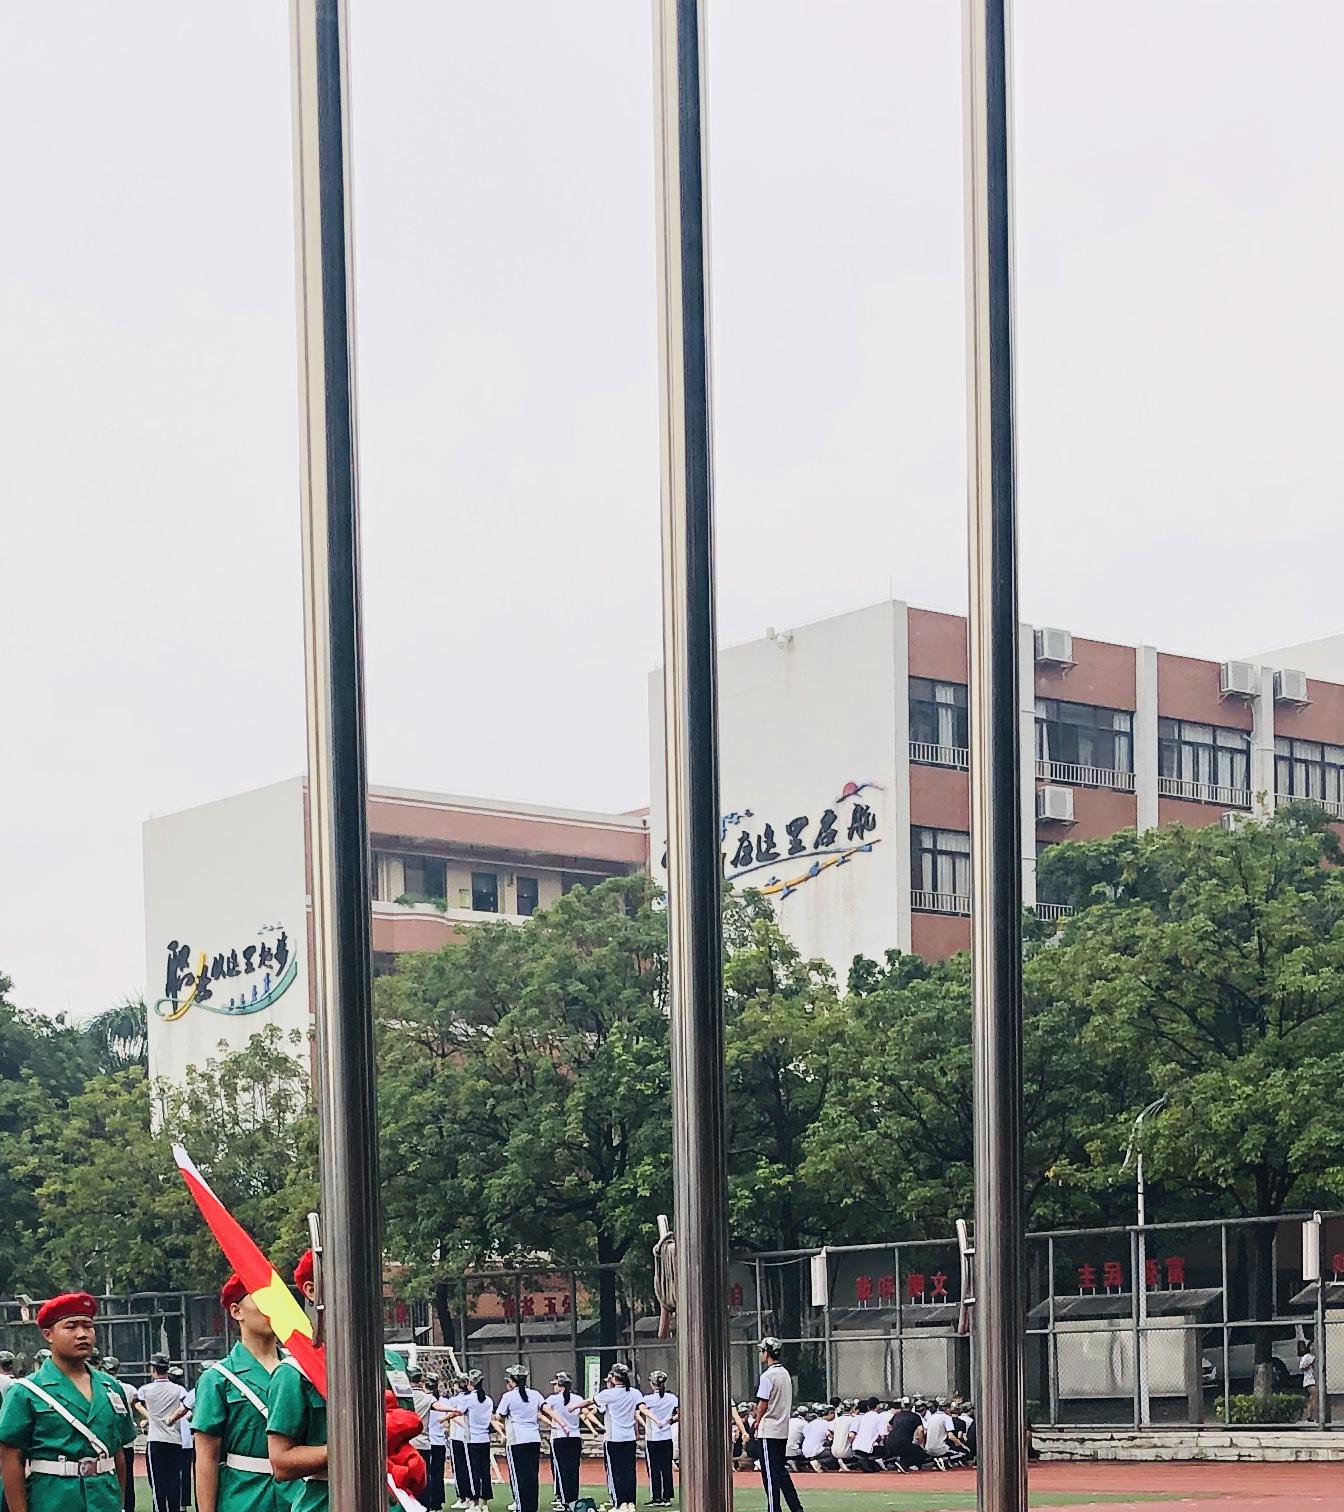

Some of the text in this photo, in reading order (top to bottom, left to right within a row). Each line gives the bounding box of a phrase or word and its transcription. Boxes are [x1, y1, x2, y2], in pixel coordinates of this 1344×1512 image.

[661, 803, 876, 873] 在这里启航
